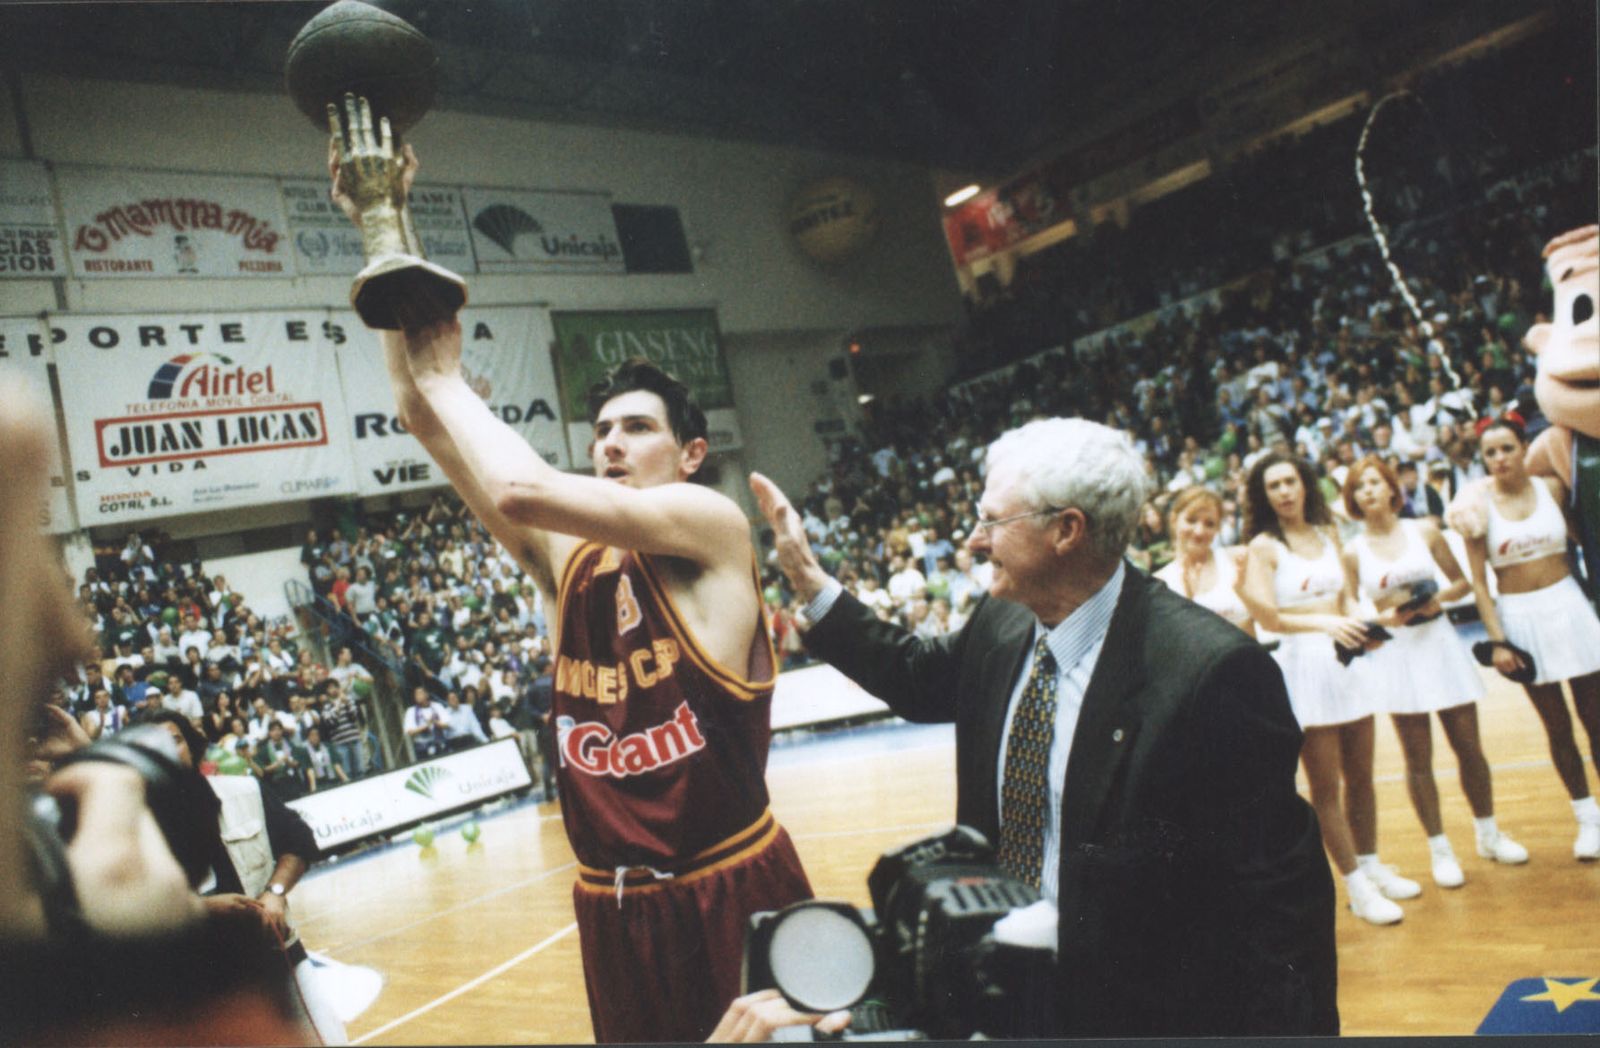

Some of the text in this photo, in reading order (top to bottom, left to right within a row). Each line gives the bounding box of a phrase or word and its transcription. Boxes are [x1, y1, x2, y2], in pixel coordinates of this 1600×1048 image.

[228, 210, 280, 253] mia
[541, 233, 618, 260] Unicaja
[84, 260, 154, 272] RISTORANTE
[180, 363, 274, 397] Airtel
[110, 411, 318, 457] JUAN LUCAS
[127, 460, 207, 478] VIDA
[315, 808, 383, 839] Unicaja
